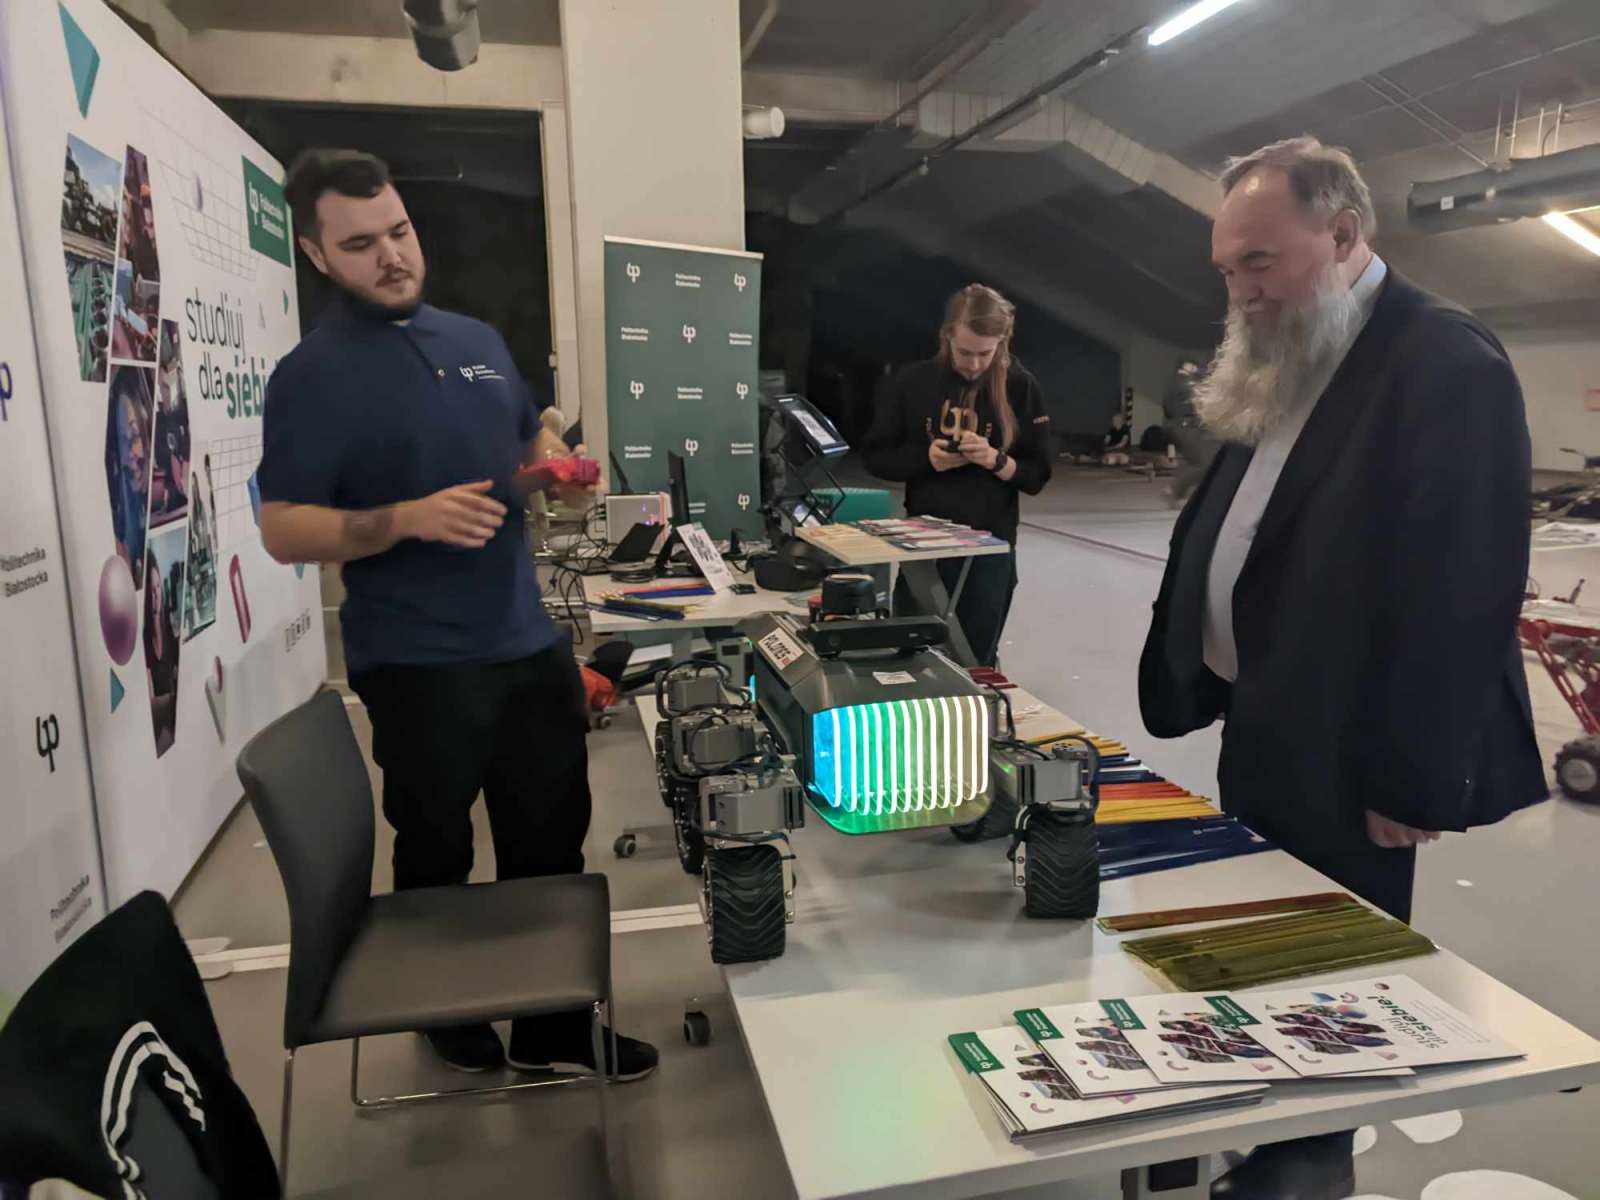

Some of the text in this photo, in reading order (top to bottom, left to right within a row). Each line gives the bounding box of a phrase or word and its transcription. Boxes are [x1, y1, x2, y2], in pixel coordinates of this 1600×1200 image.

[185, 287, 246, 364] studiuj
[198, 351, 224, 400] dla
[1366, 995, 1433, 1032] siebie!
